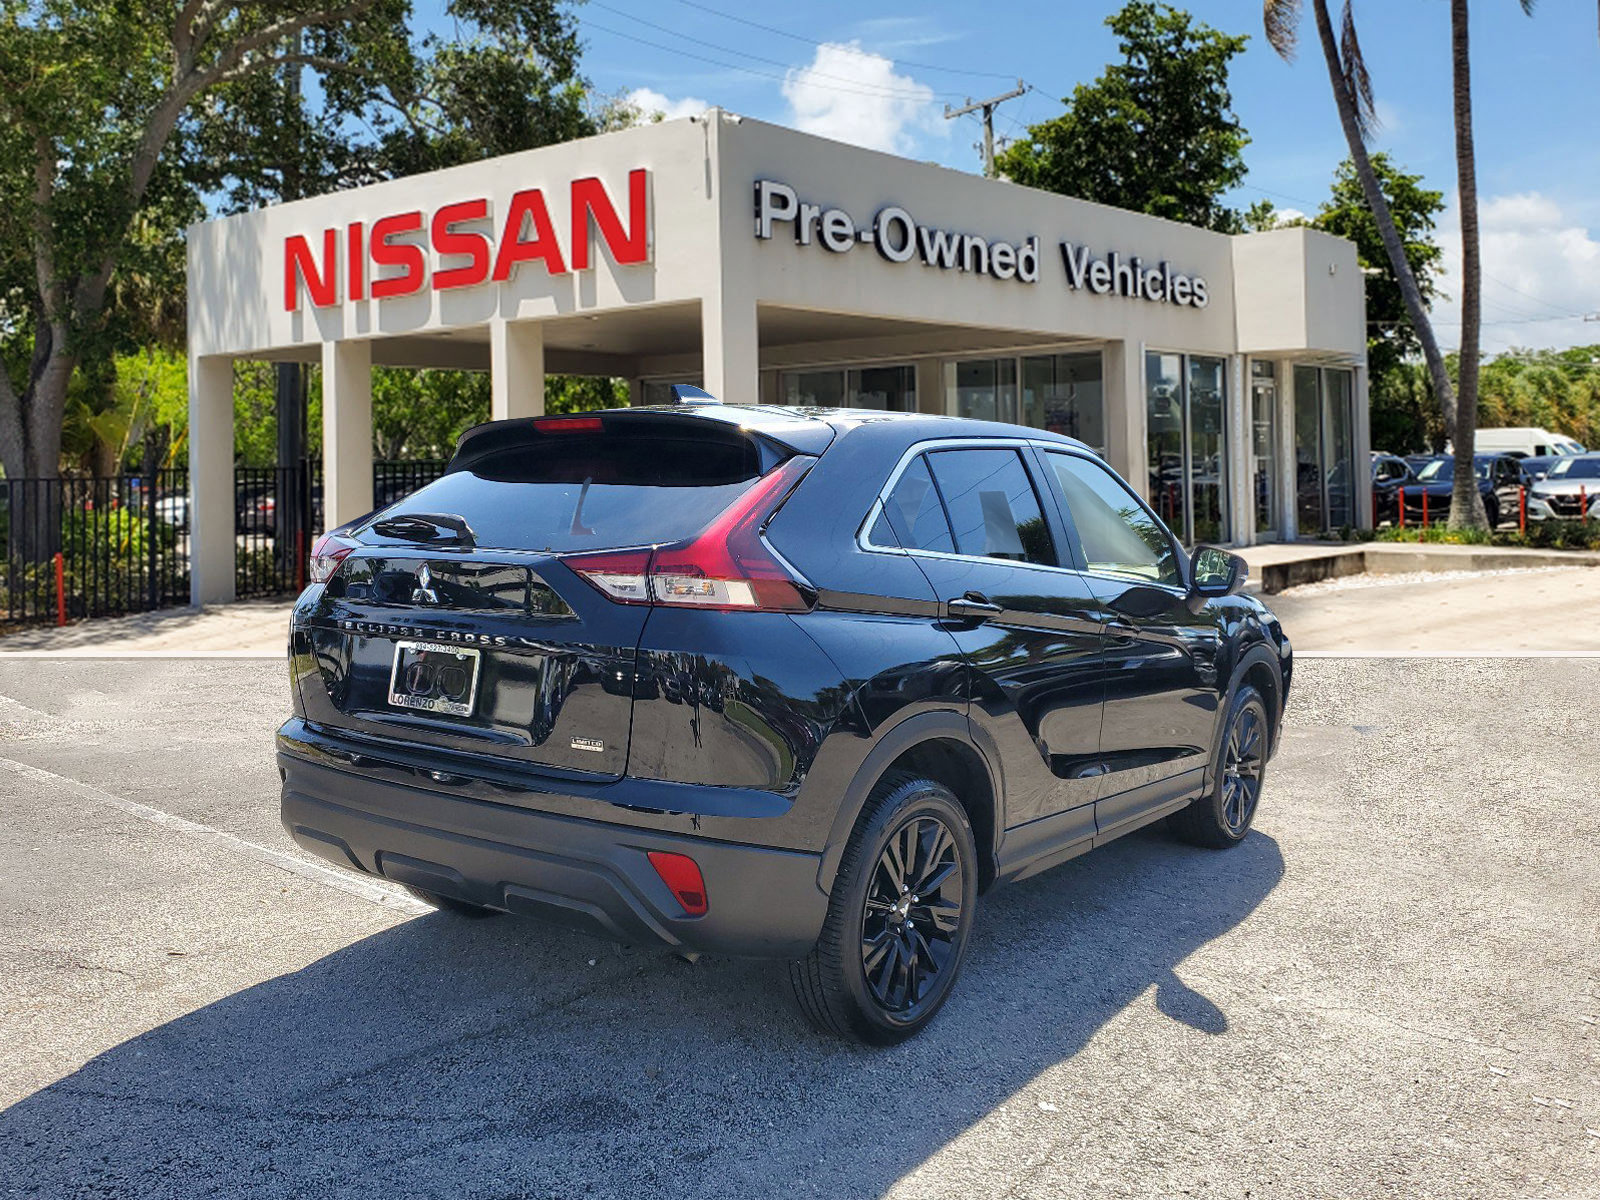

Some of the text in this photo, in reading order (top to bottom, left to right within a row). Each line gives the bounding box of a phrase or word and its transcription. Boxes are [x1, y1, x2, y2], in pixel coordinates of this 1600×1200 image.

[284, 167, 652, 312] NISSAN
[754, 179, 1209, 309] Pre-Owned Vehicles
[390, 693, 435, 710] LORENZO
